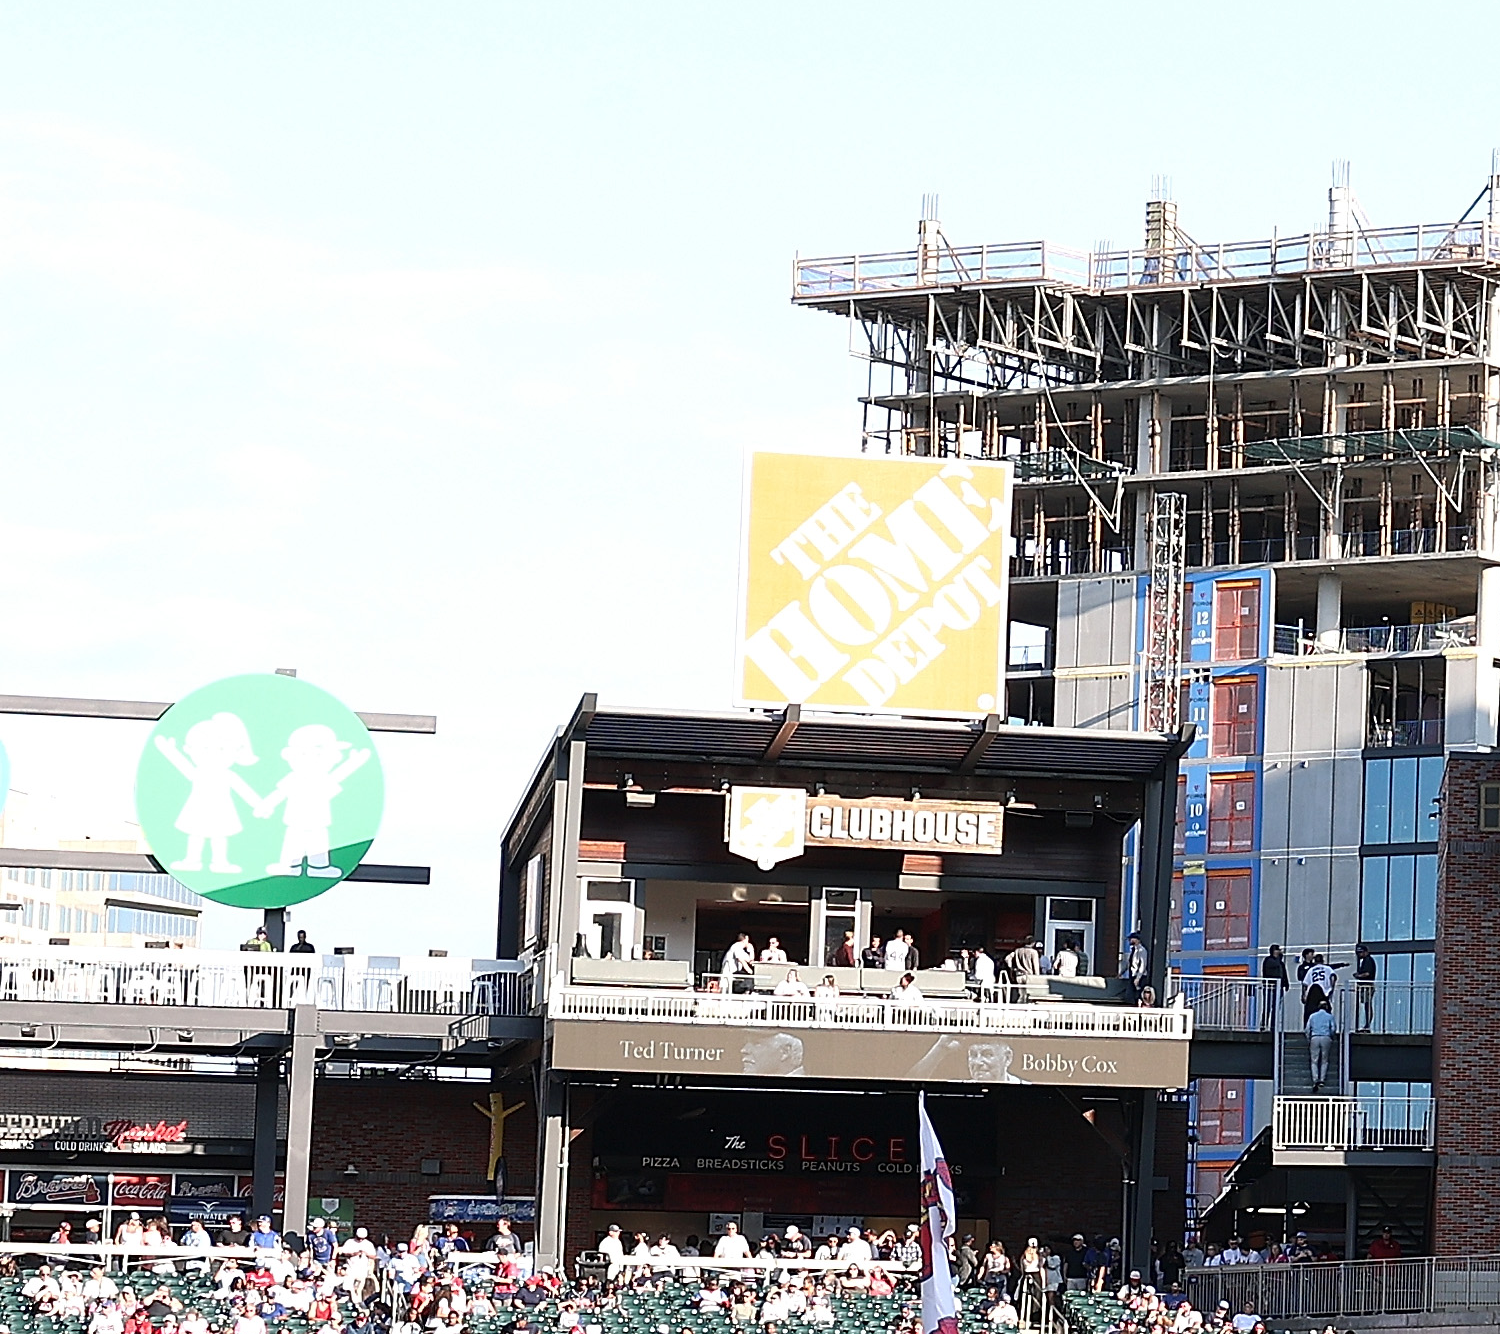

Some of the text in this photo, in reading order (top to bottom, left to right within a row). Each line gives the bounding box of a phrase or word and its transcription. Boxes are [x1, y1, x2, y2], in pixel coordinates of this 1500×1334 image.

[769, 481, 883, 581] THE
[742, 463, 1003, 705] HOME
[1195, 611, 1209, 626] 12
[842, 554, 1001, 708] DEPOT
[1193, 707, 1205, 721] 11
[1189, 803, 1203, 818] 10
[809, 804, 997, 846] CLUBHOUSE
[1189, 900, 1197, 915] 9
[1311, 970, 1326, 982] 25
[618, 1040, 725, 1062] Ted Turner
[1021, 1052, 1118, 1076] Bobby Cox
[0, 1114, 188, 1150] ERFIELD Market
[54, 1141, 77, 1151] COLD
[132, 1142, 167, 1153] SALADS
[724, 1134, 906, 1162] The SLICE
[641, 1156, 681, 1168] PIZZA
[696, 1158, 785, 1171] BREADSTICKS
[801, 1161, 861, 1173] PEANUTS
[876, 1162, 910, 1174] COLD
[16, 1173, 92, 1202] Braves
[188, 1212, 228, 1221] CUTWATER
